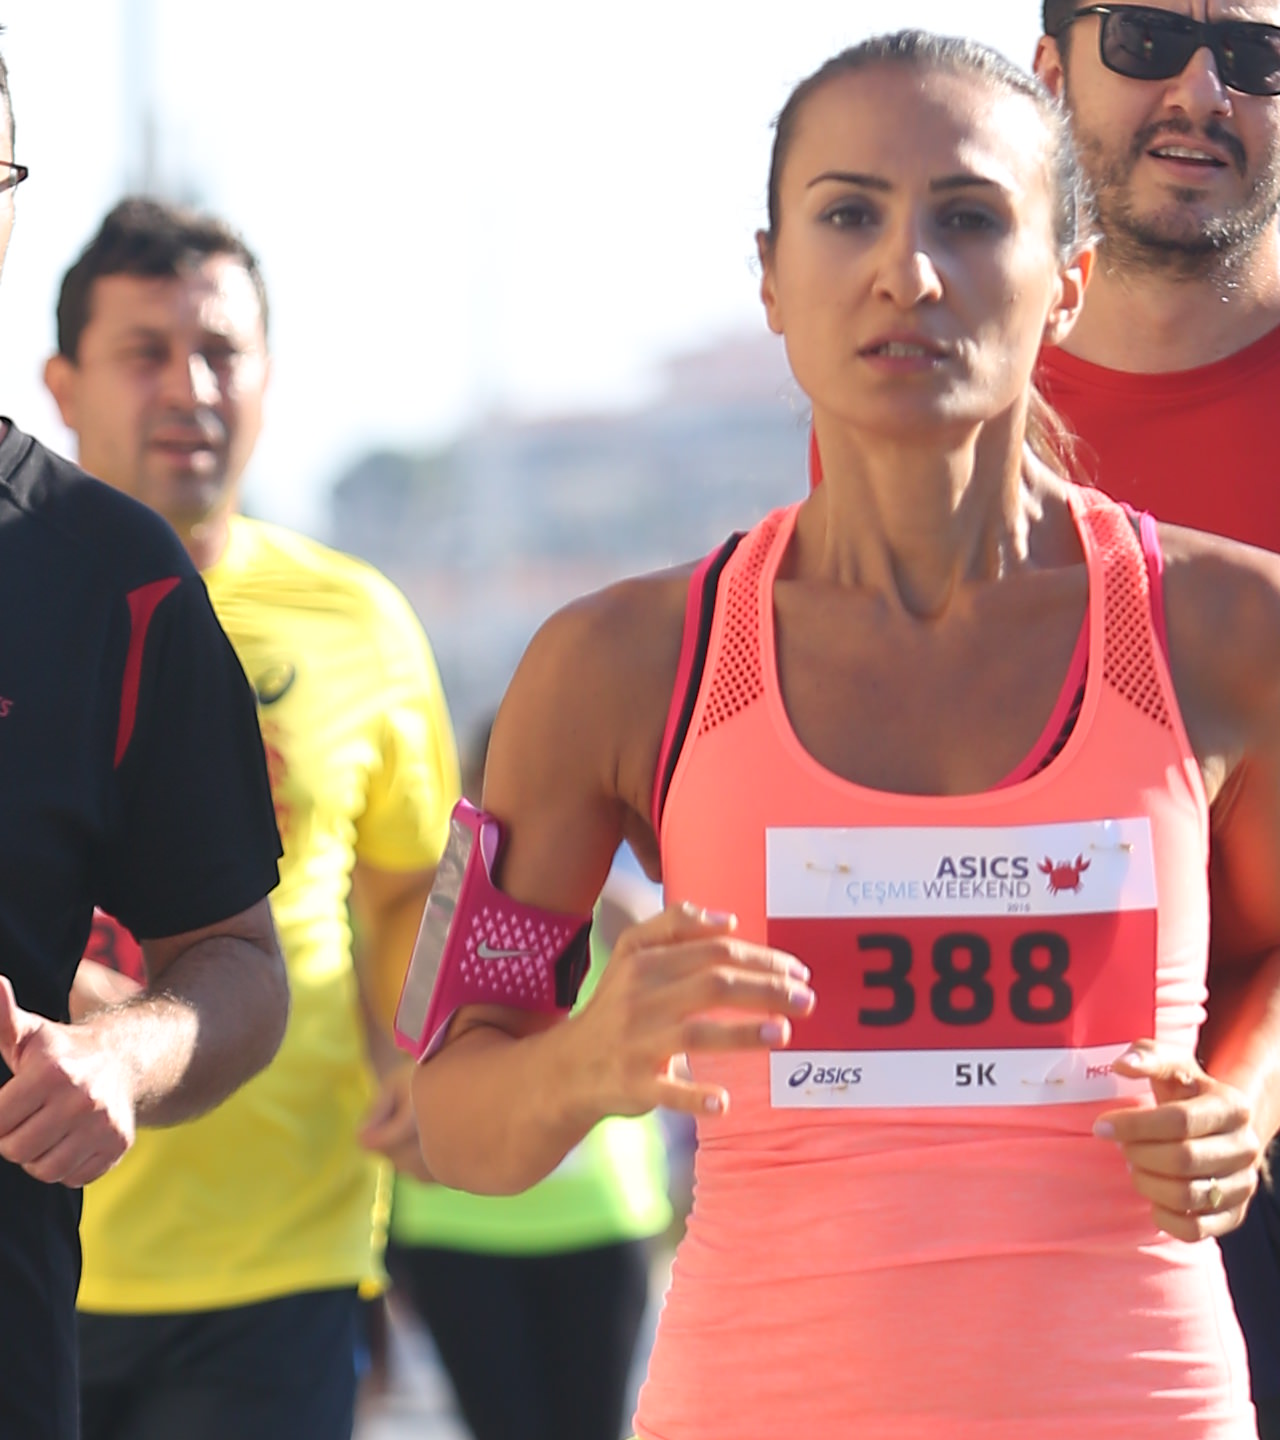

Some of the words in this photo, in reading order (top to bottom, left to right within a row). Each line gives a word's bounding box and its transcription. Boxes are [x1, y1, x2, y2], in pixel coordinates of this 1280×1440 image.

[936, 856, 1030, 879] ASICS
[846, 880, 919, 906] ÇEŞME
[923, 880, 1031, 899] WEEKEND
[856, 930, 1074, 1028] 388
[812, 1066, 863, 1085] asics
[954, 1063, 997, 1087] 5K
